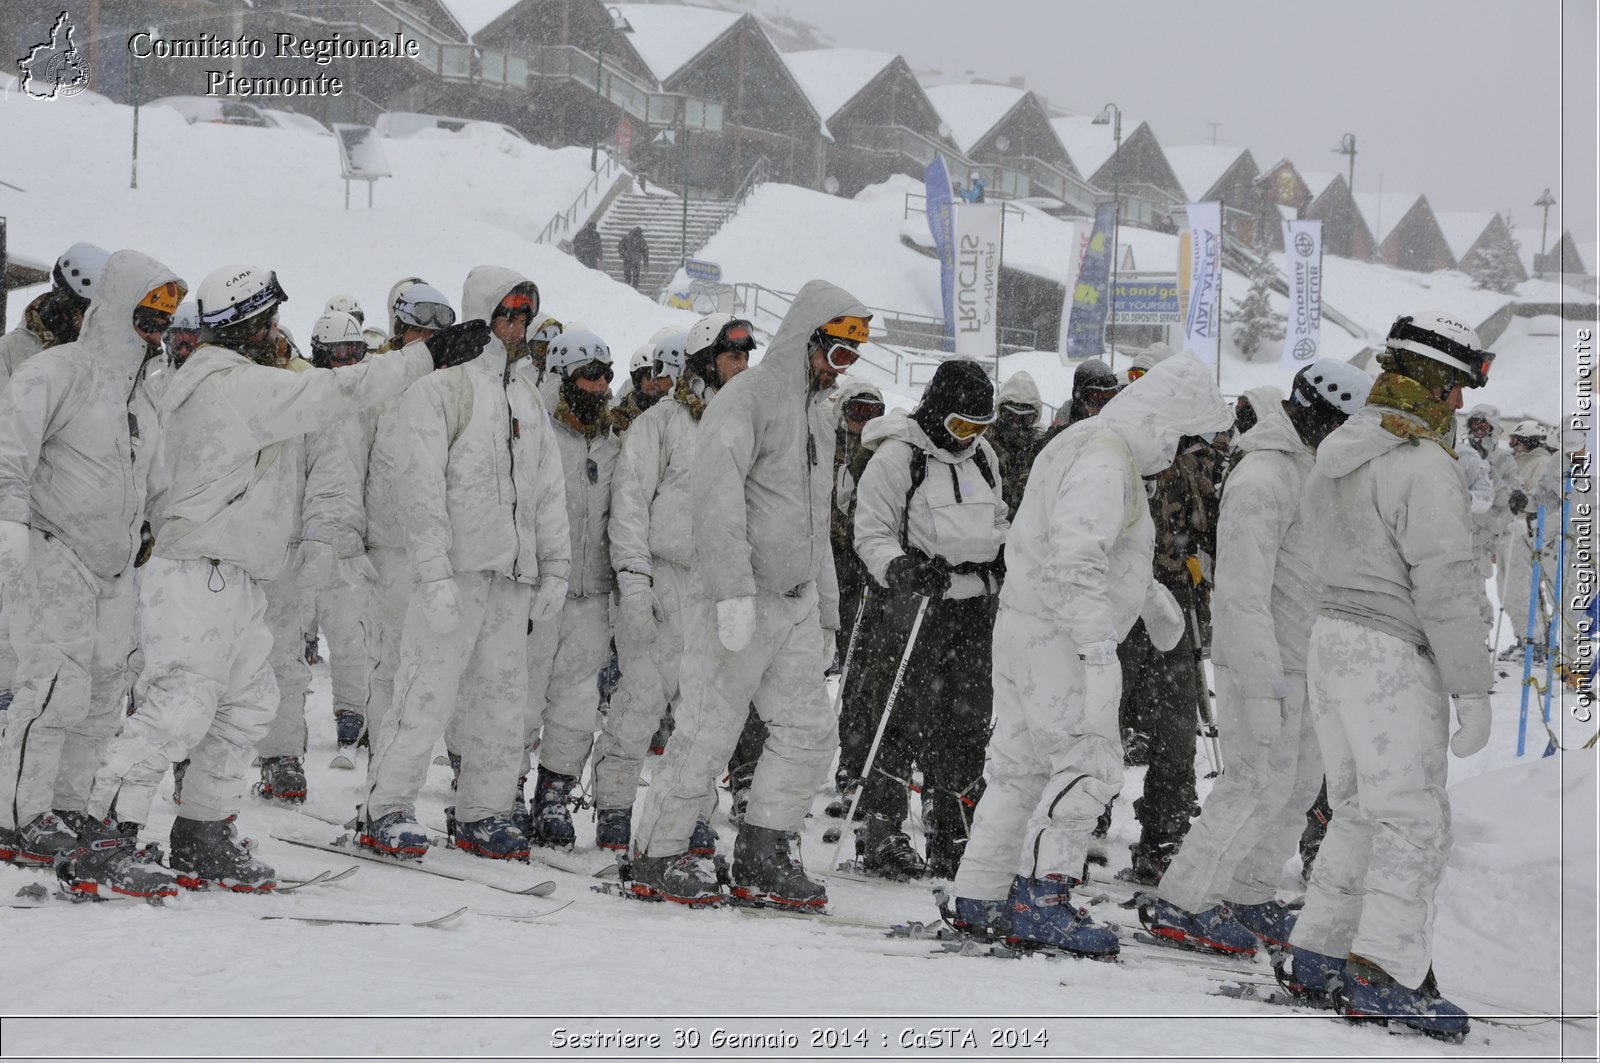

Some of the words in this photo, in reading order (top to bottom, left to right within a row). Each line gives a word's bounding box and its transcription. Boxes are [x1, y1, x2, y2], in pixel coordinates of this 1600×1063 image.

[225, 270, 252, 288] CAMP
[1129, 284, 1157, 297] and
[1159, 287, 1179, 300] go
